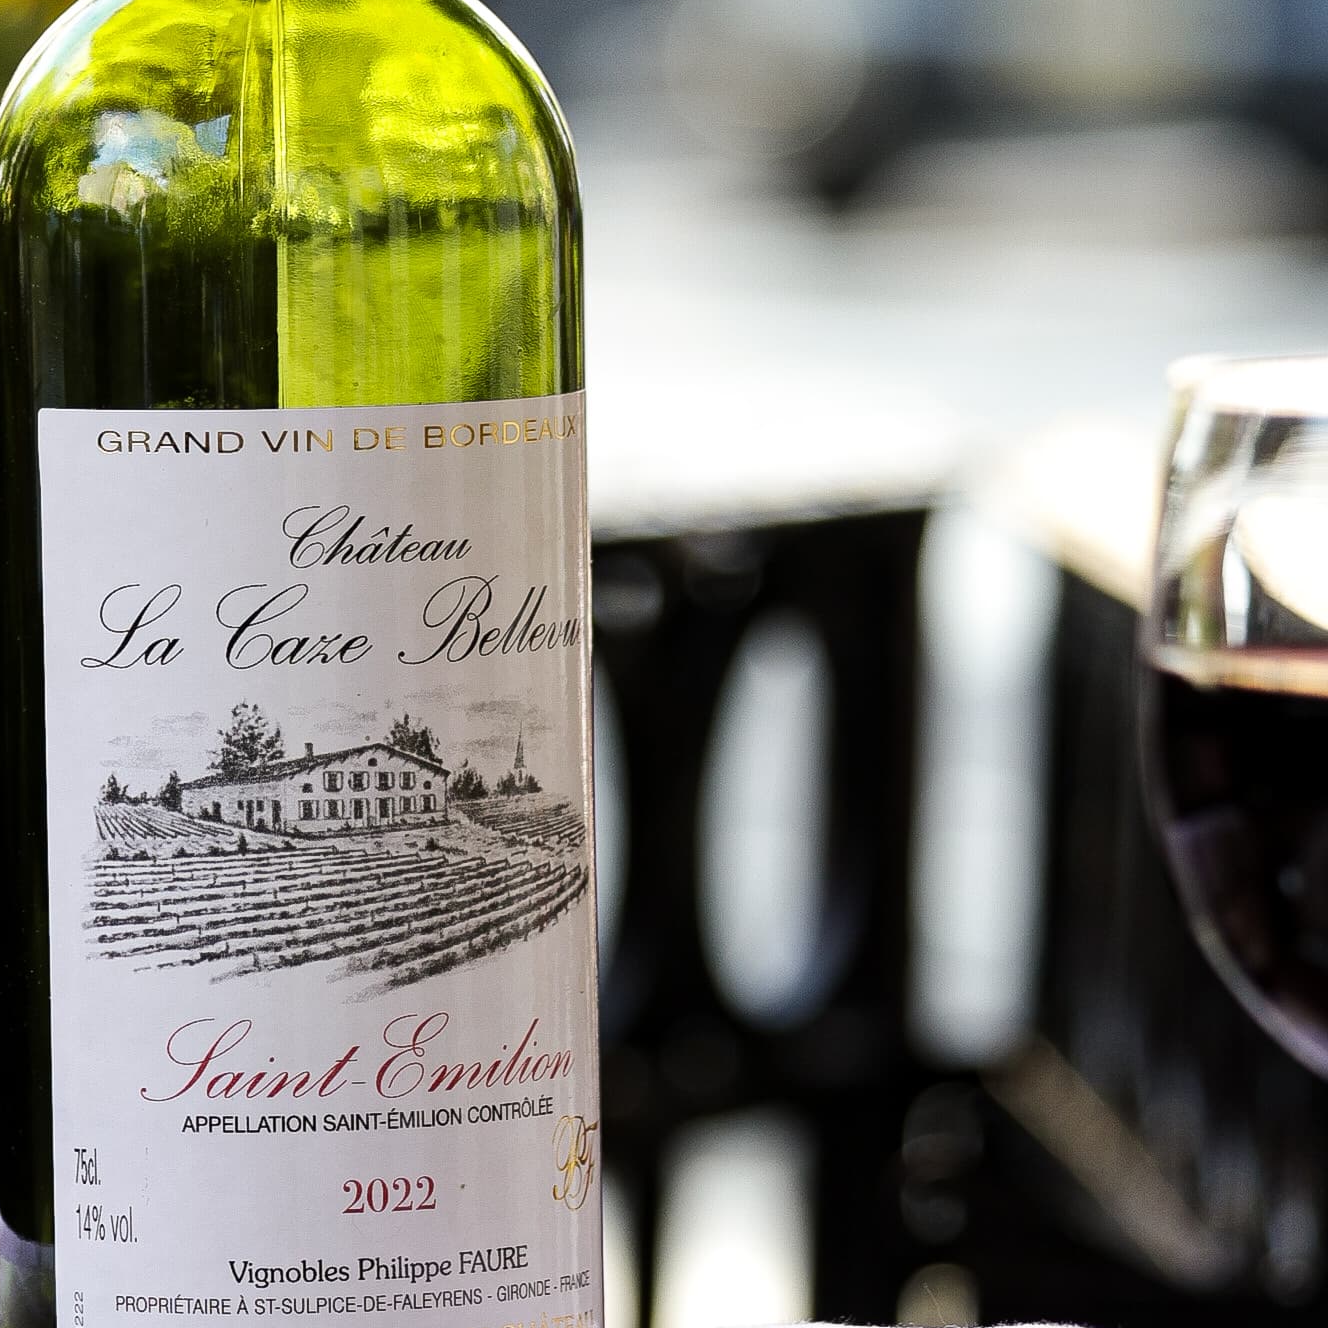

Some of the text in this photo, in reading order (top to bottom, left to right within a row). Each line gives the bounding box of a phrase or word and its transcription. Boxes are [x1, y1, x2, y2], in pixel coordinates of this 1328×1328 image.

[97, 415, 577, 454] GRAND VIN DE BORDEAUX
[282, 504, 473, 569] Château
[80, 583, 185, 670] La
[216, 582, 374, 670] Caze
[181, 1095, 554, 1134] APPELLATION SAINT-ÉMILION CONTRÔLÉE
[342, 1175, 437, 1214] 2022
[76, 1204, 138, 1243] 14% vol.
[228, 1245, 529, 1289] Vignobles Philippe FAURE
[115, 1294, 232, 1315] PROPRIÉTAIRE
[237, 1295, 249, 1315] À
[254, 1288, 483, 1315] ST-SULPICE-DE-FALEYRENS
[496, 1279, 551, 1302] GIRONDE
[559, 1270, 591, 1293] FRANCE
